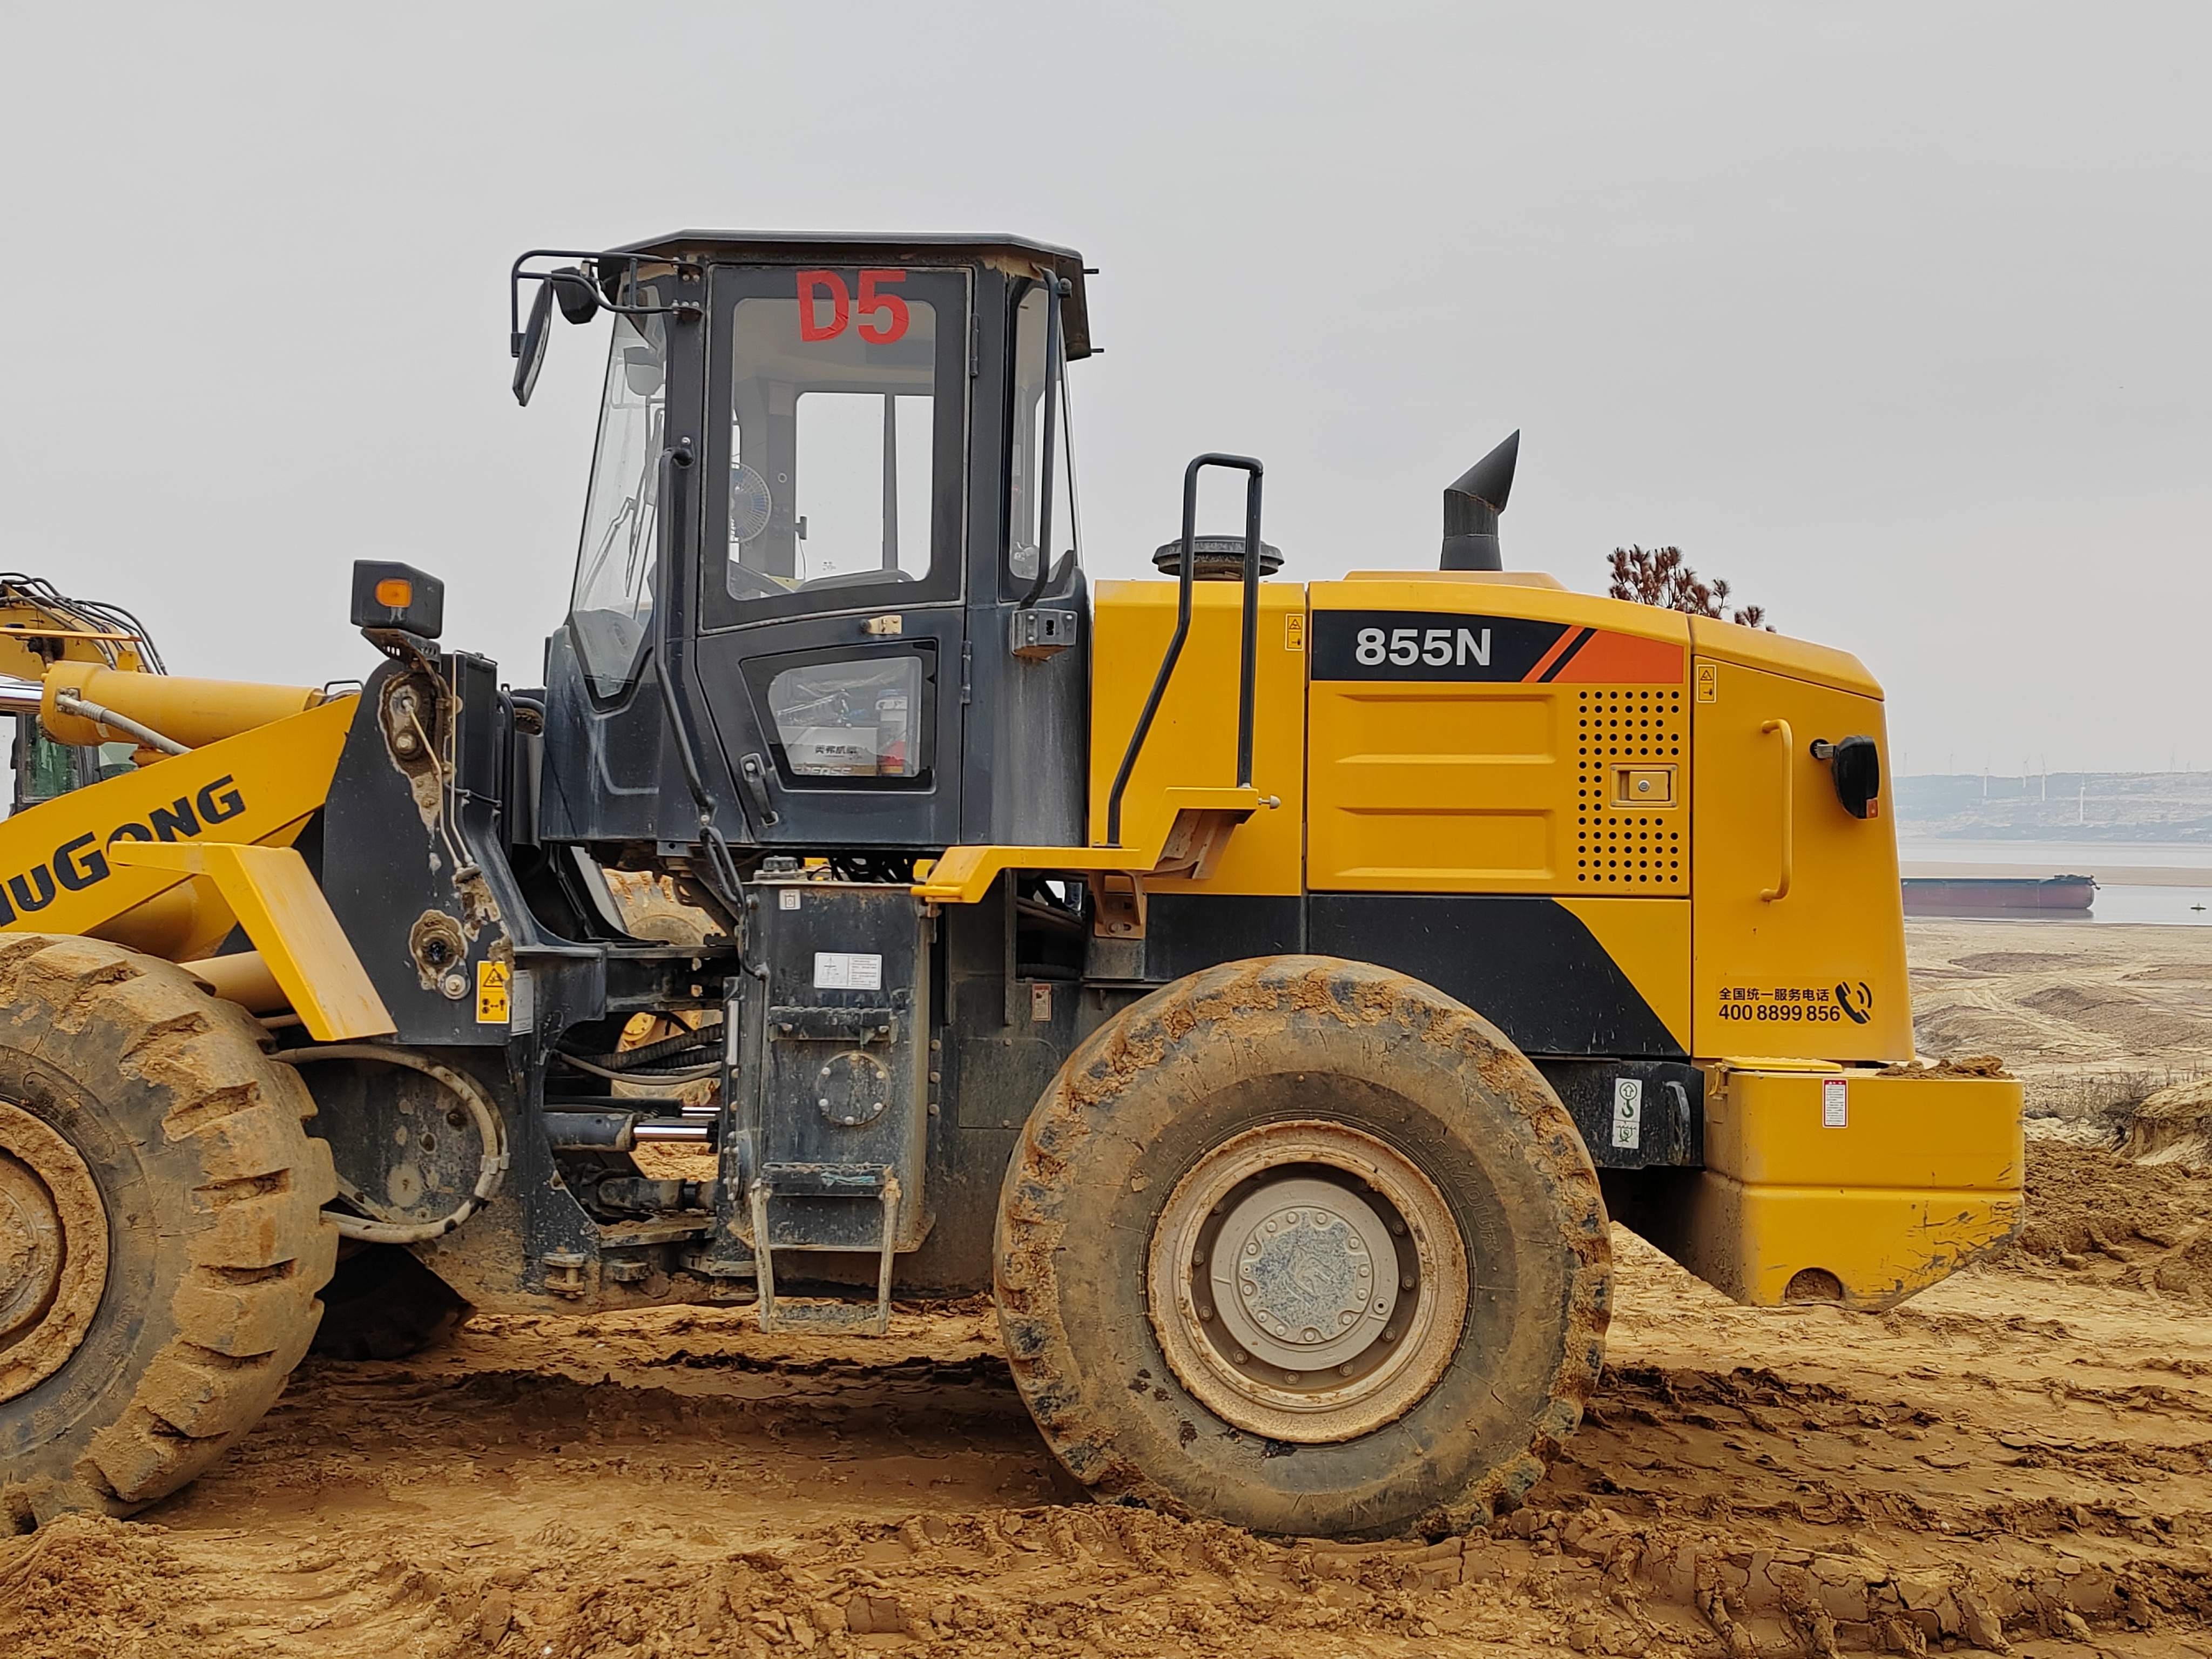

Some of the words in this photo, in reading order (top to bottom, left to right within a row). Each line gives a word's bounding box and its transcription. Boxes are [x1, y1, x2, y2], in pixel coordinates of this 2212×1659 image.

[797, 269, 909, 345] D5
[1355, 628, 1491, 666] 855N
[1718, 1004, 1752, 1020] 400
[1757, 1005, 1802, 1021] 8899
[1806, 1006, 1840, 1021] 856
[1719, 987, 1830, 1002] 全国统一服务电话
[1406, 1125, 1502, 1252] ARMOUR
